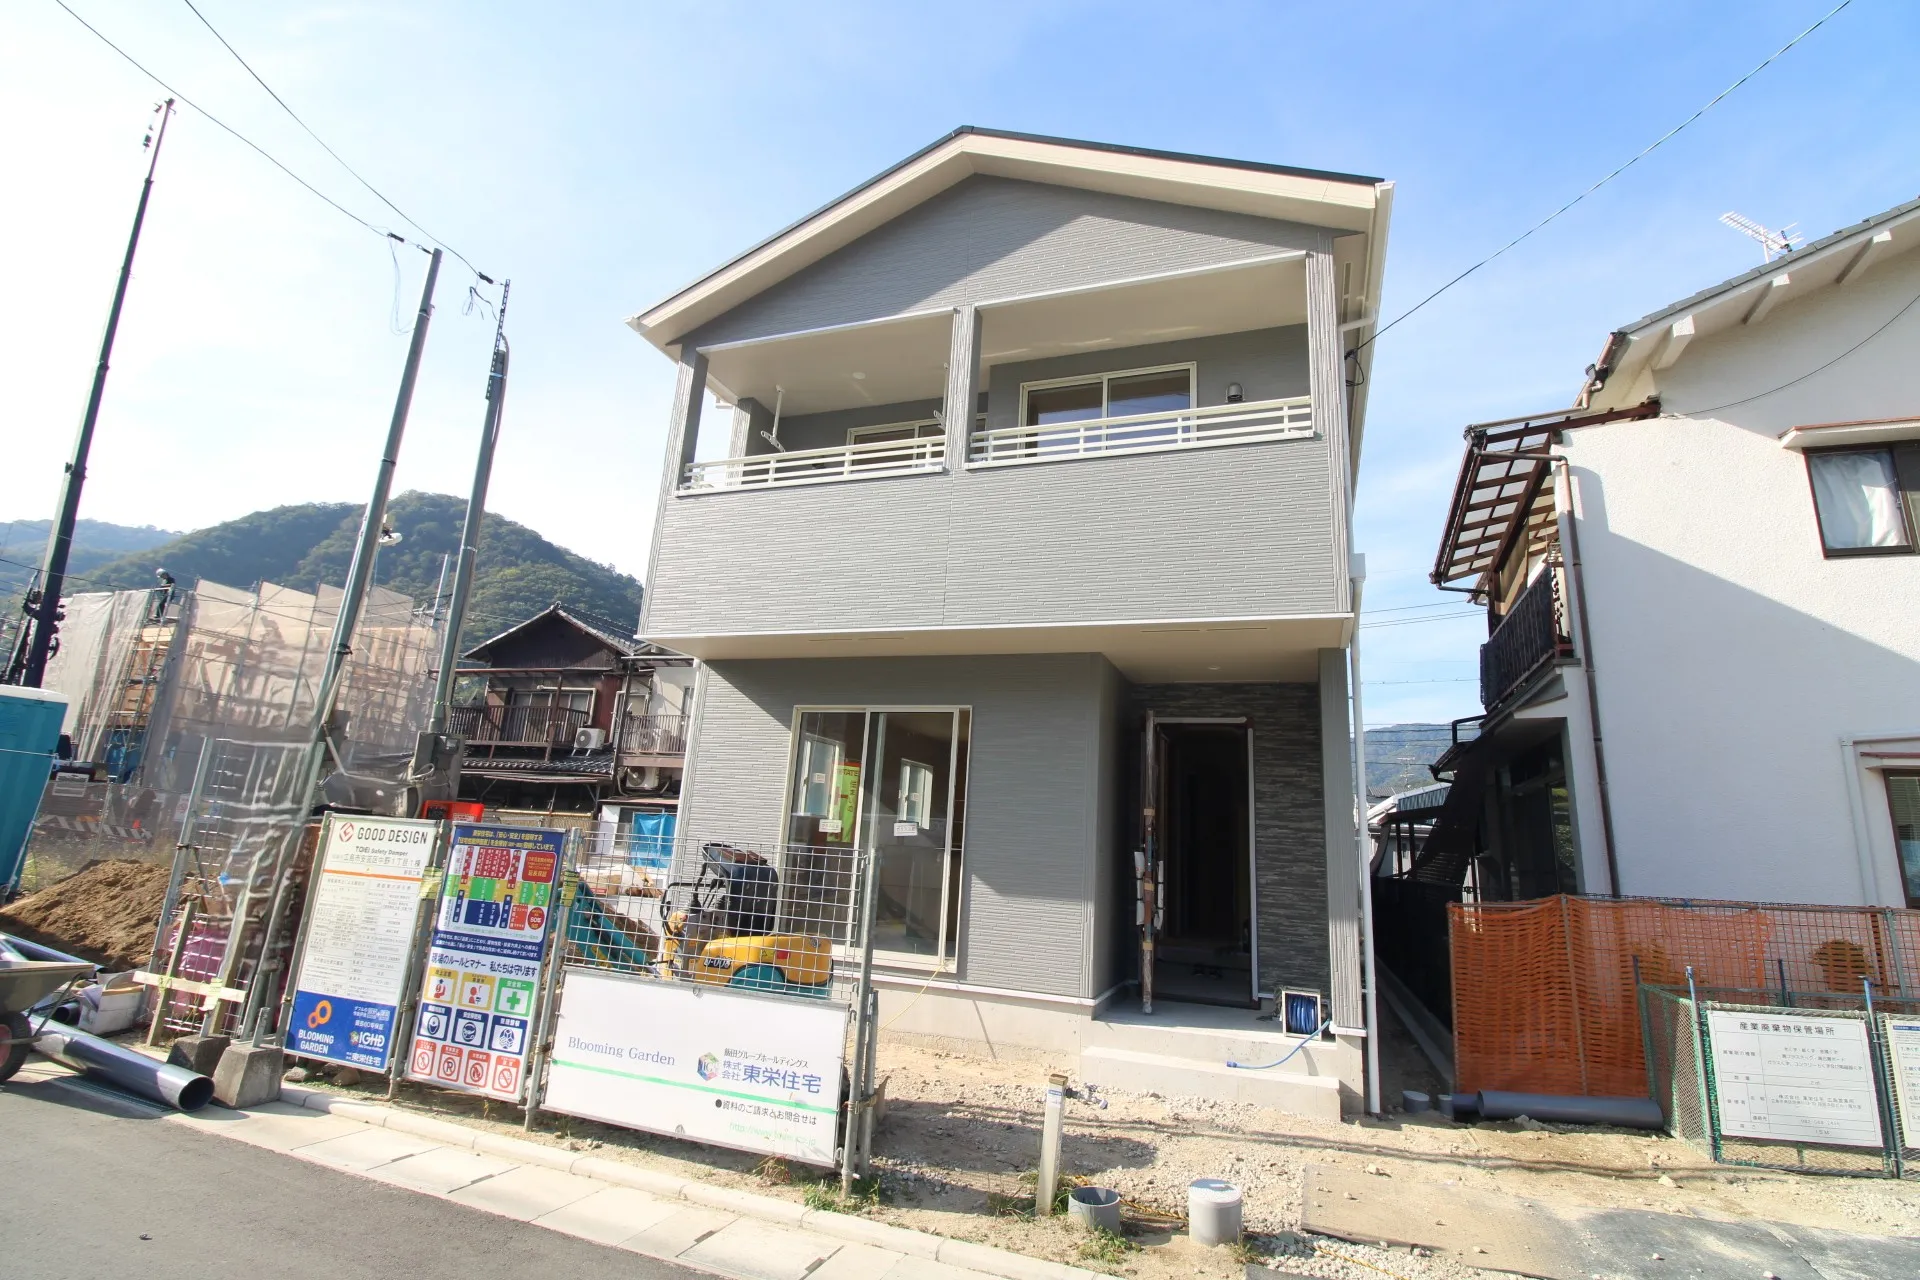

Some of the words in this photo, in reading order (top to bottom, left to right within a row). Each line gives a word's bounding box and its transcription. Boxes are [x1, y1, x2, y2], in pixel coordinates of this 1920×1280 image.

[357, 827, 385, 841] GOOD
[388, 830, 428, 844] DESIGN
[371, 847, 387, 856] Safety
[388, 849, 408, 857] Damper
[431, 952, 486, 969] 現場のルールとマナー
[489, 960, 538, 977] 私たちは守ります
[298, 1029, 334, 1045] BLOOMING
[1739, 1022, 1835, 1036] 産業廃棄物保管場所
[359, 1031, 385, 1048] IGHD
[300, 1041, 328, 1055] GARDEN
[568, 1036, 624, 1058] Blooming
[628, 1047, 676, 1067] Garden
[723, 1060, 742, 1072] 株式
[722, 1070, 741, 1081] 会社
[742, 1064, 822, 1094] 東栄住宅
